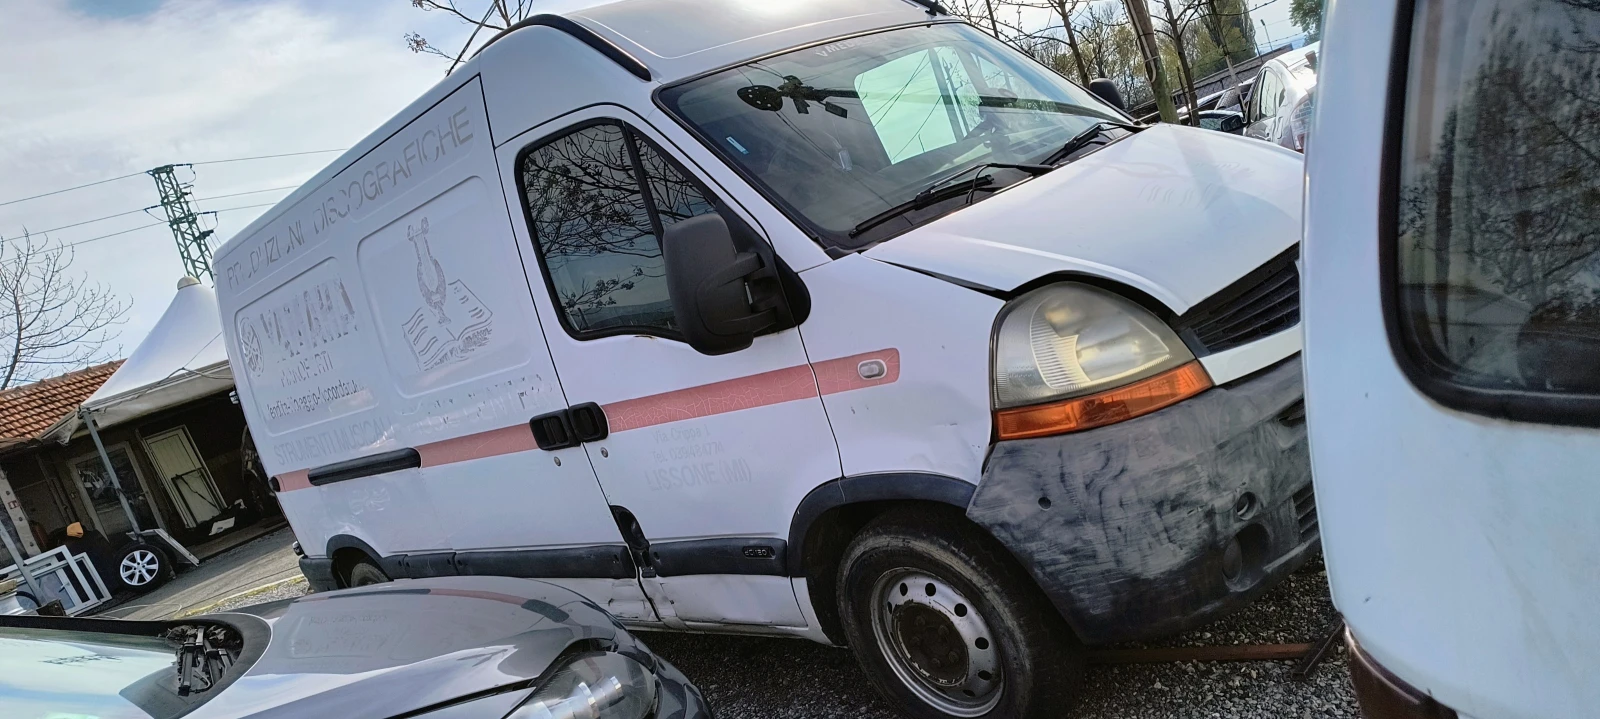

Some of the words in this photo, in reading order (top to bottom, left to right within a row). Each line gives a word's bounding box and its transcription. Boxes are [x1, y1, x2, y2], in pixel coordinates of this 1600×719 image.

[652, 428, 668, 444] Via
[671, 426, 701, 442] Crippa
[273, 433, 335, 466] STRUMENTI
[652, 449, 668, 464] Tel.
[644, 461, 719, 492] LISSONE
[719, 458, 752, 484] (MI)
